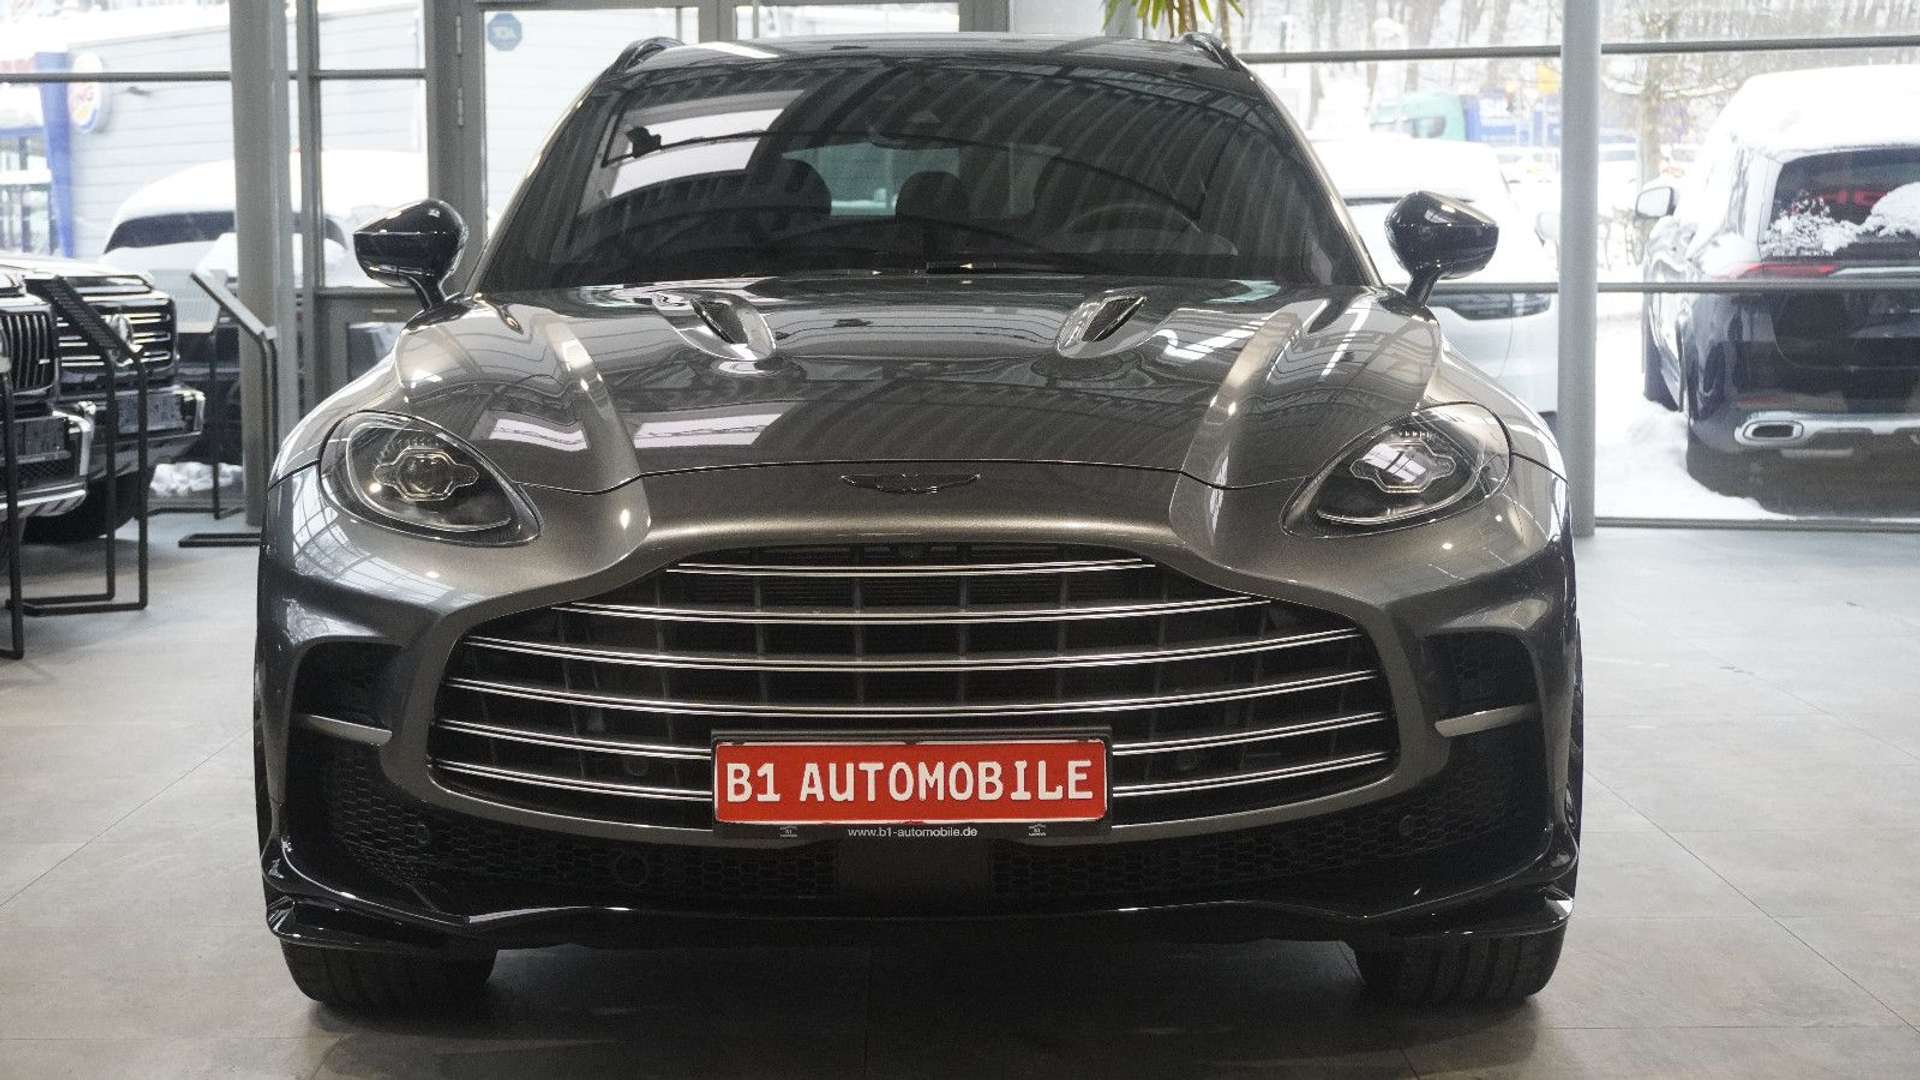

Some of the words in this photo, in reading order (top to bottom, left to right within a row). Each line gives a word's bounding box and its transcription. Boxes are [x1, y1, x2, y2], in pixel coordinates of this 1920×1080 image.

[726, 762, 780, 803] B1
[799, 759, 1093, 802] AUTOMOBILE
[847, 826, 978, 838] www.b1-automobile.de
